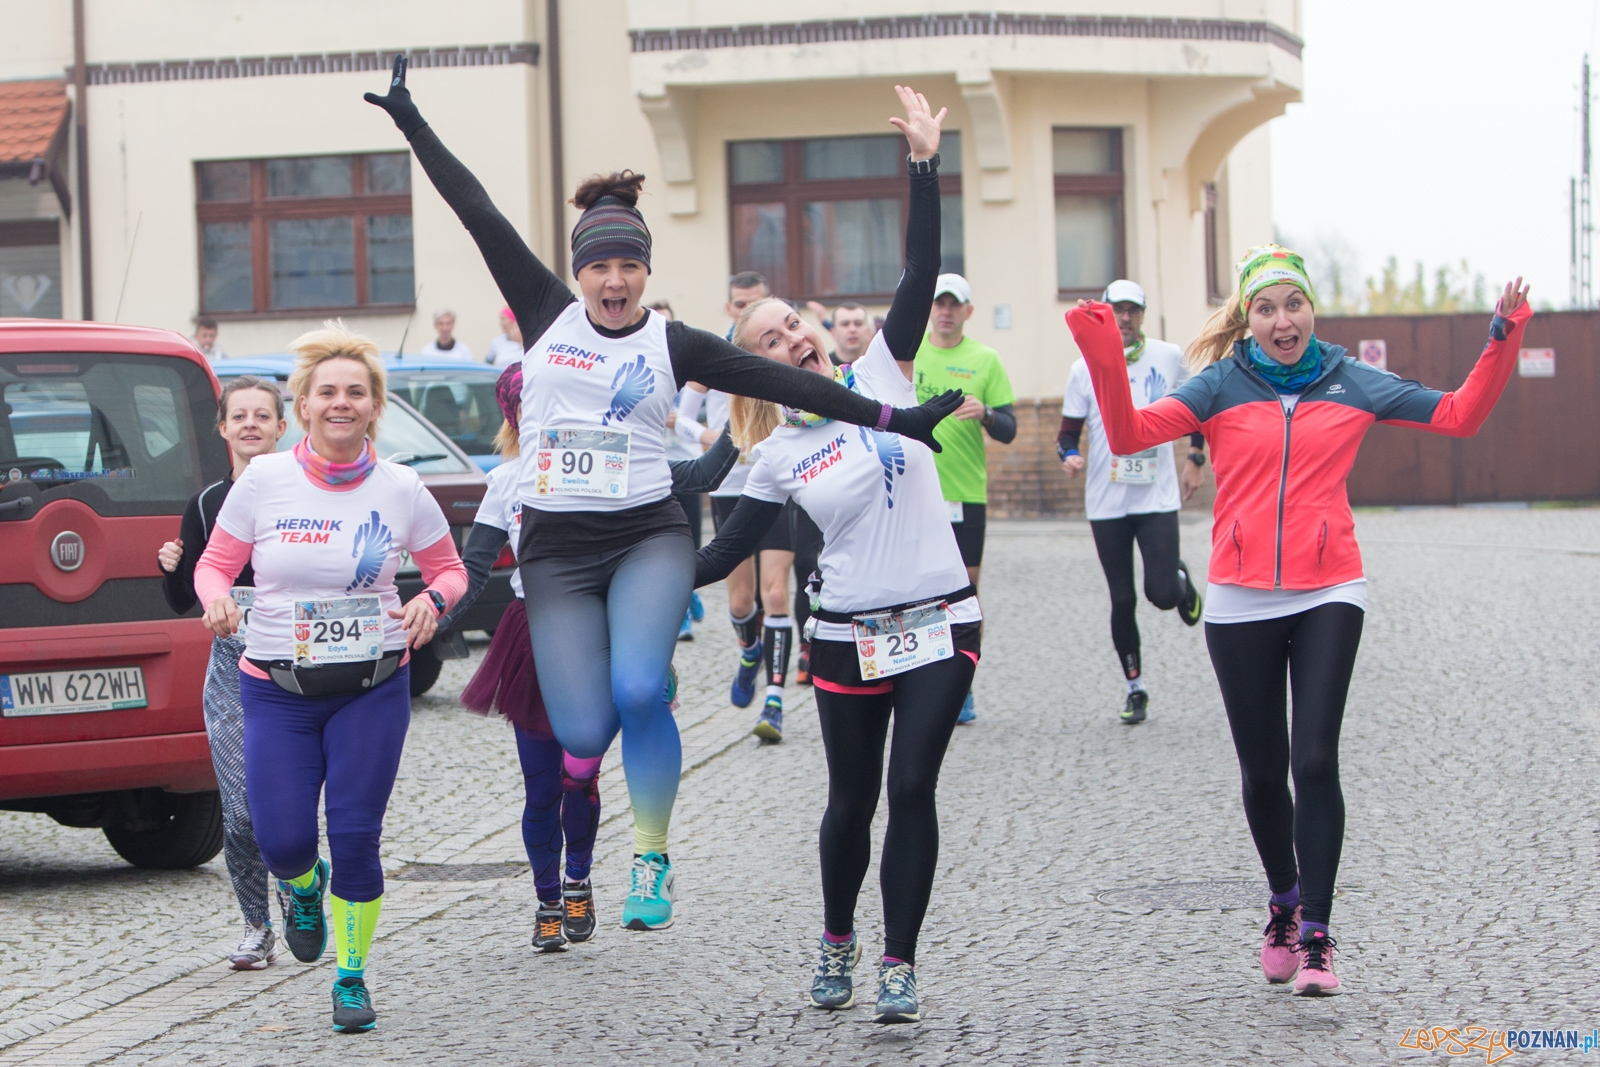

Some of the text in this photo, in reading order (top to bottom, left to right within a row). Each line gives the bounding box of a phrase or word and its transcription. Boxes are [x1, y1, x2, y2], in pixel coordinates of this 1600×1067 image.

[546, 343, 609, 364] HERNIK
[547, 354, 594, 371] TEAM
[561, 450, 593, 475] 90
[792, 432, 847, 479] HERNIK
[800, 450, 842, 484] TEAM
[1125, 458, 1143, 473] 35
[562, 477, 589, 485] Ewelina
[276, 518, 343, 532] HERNIK
[280, 532, 330, 544] TEAM
[59, 542, 78, 561] FIAT
[313, 618, 362, 644] 294
[327, 645, 348, 653] Edyta
[886, 632, 919, 657] 23
[885, 657, 931, 674] POLINOVA POLSKA
[893, 654, 917, 665] Natalia
[15, 670, 141, 706] WW 622WH
[2, 696, 13, 705] PL
